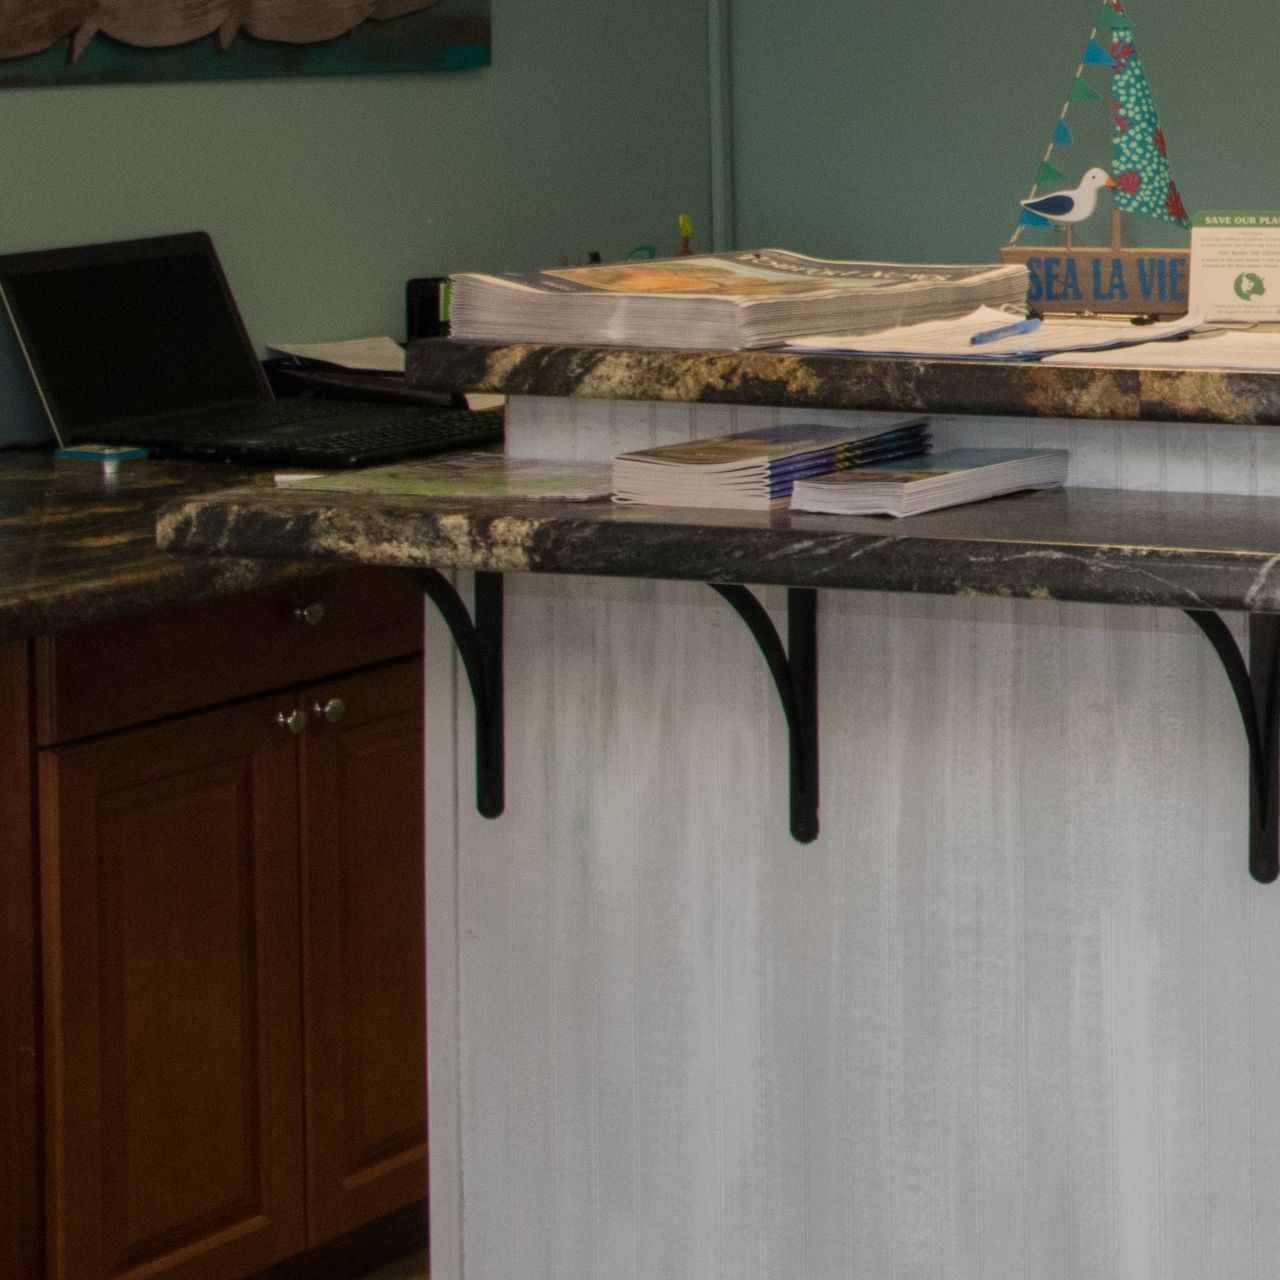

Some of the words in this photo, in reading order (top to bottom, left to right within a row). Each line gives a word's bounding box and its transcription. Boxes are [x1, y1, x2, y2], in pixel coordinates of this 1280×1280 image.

[1204, 216, 1230, 225] SAVE
[1235, 216, 1257, 225] OUR
[1026, 257, 1083, 302] SEA
[1091, 257, 1129, 301] LA
[1137, 257, 1187, 302] VIE
